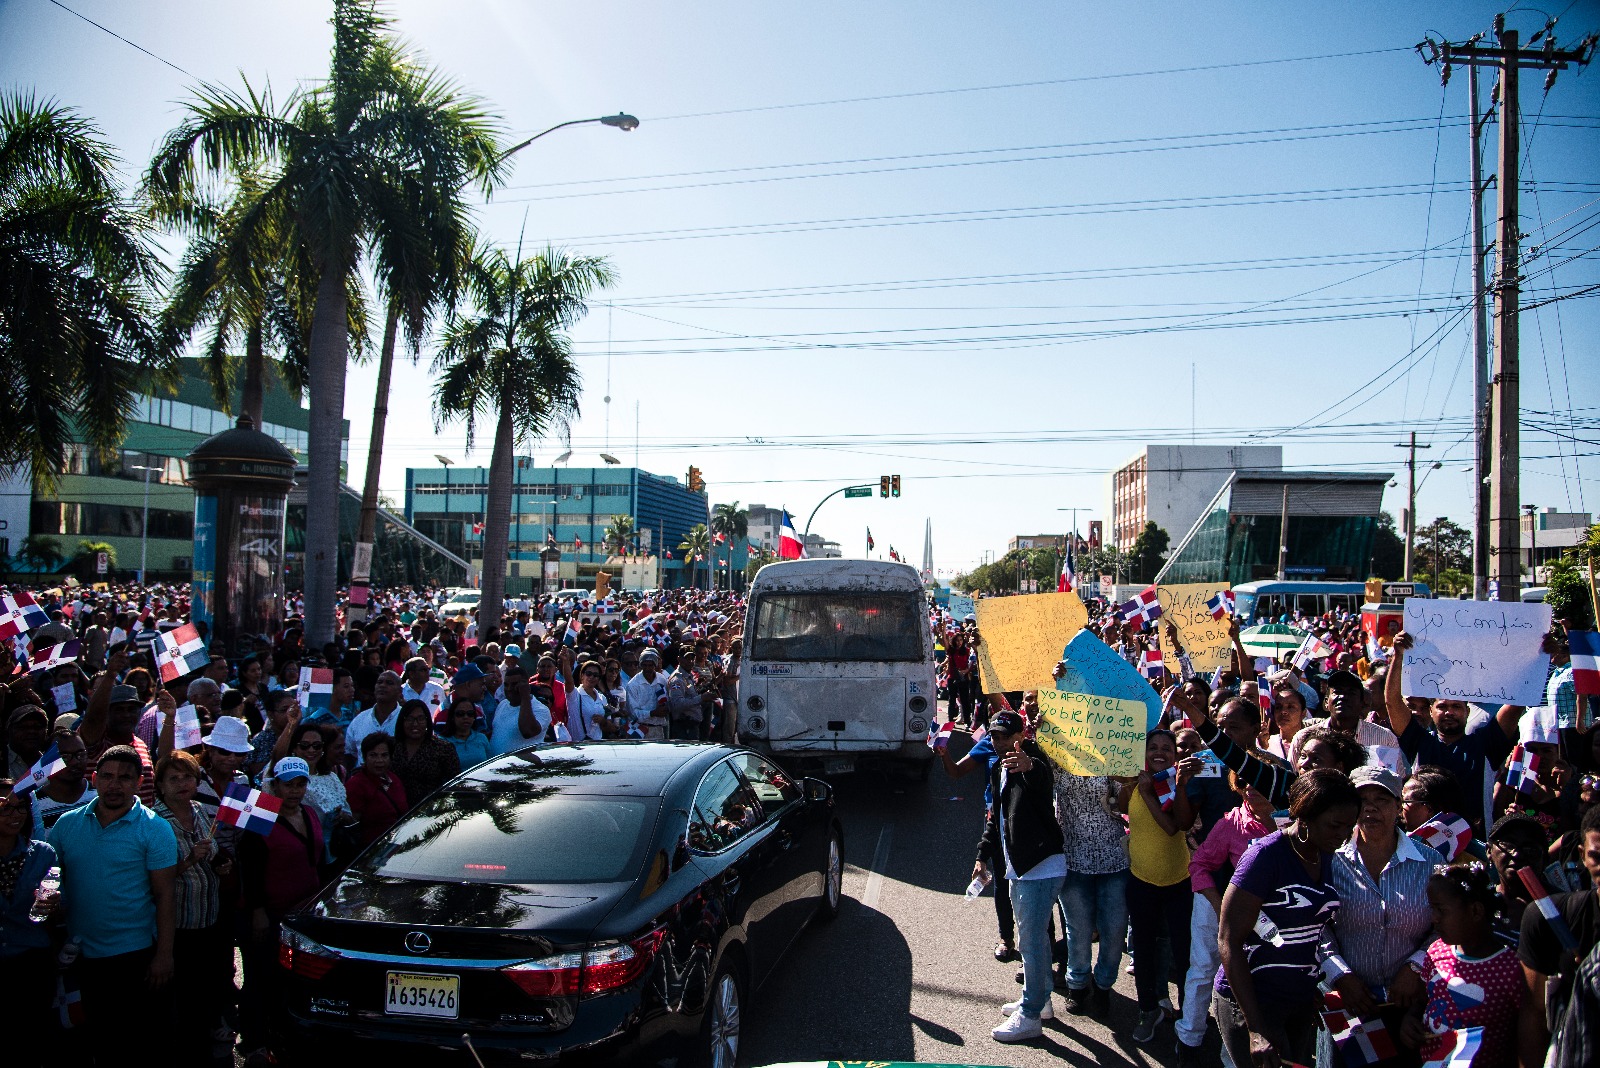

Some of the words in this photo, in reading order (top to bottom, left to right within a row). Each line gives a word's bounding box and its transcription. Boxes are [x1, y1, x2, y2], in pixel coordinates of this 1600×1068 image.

[241, 538, 278, 556] 4K
[1157, 588, 1221, 614] DANiL
[1407, 655, 1437, 666] en
[1118, 714, 1135, 728] de
[389, 985, 455, 1009] A635426
